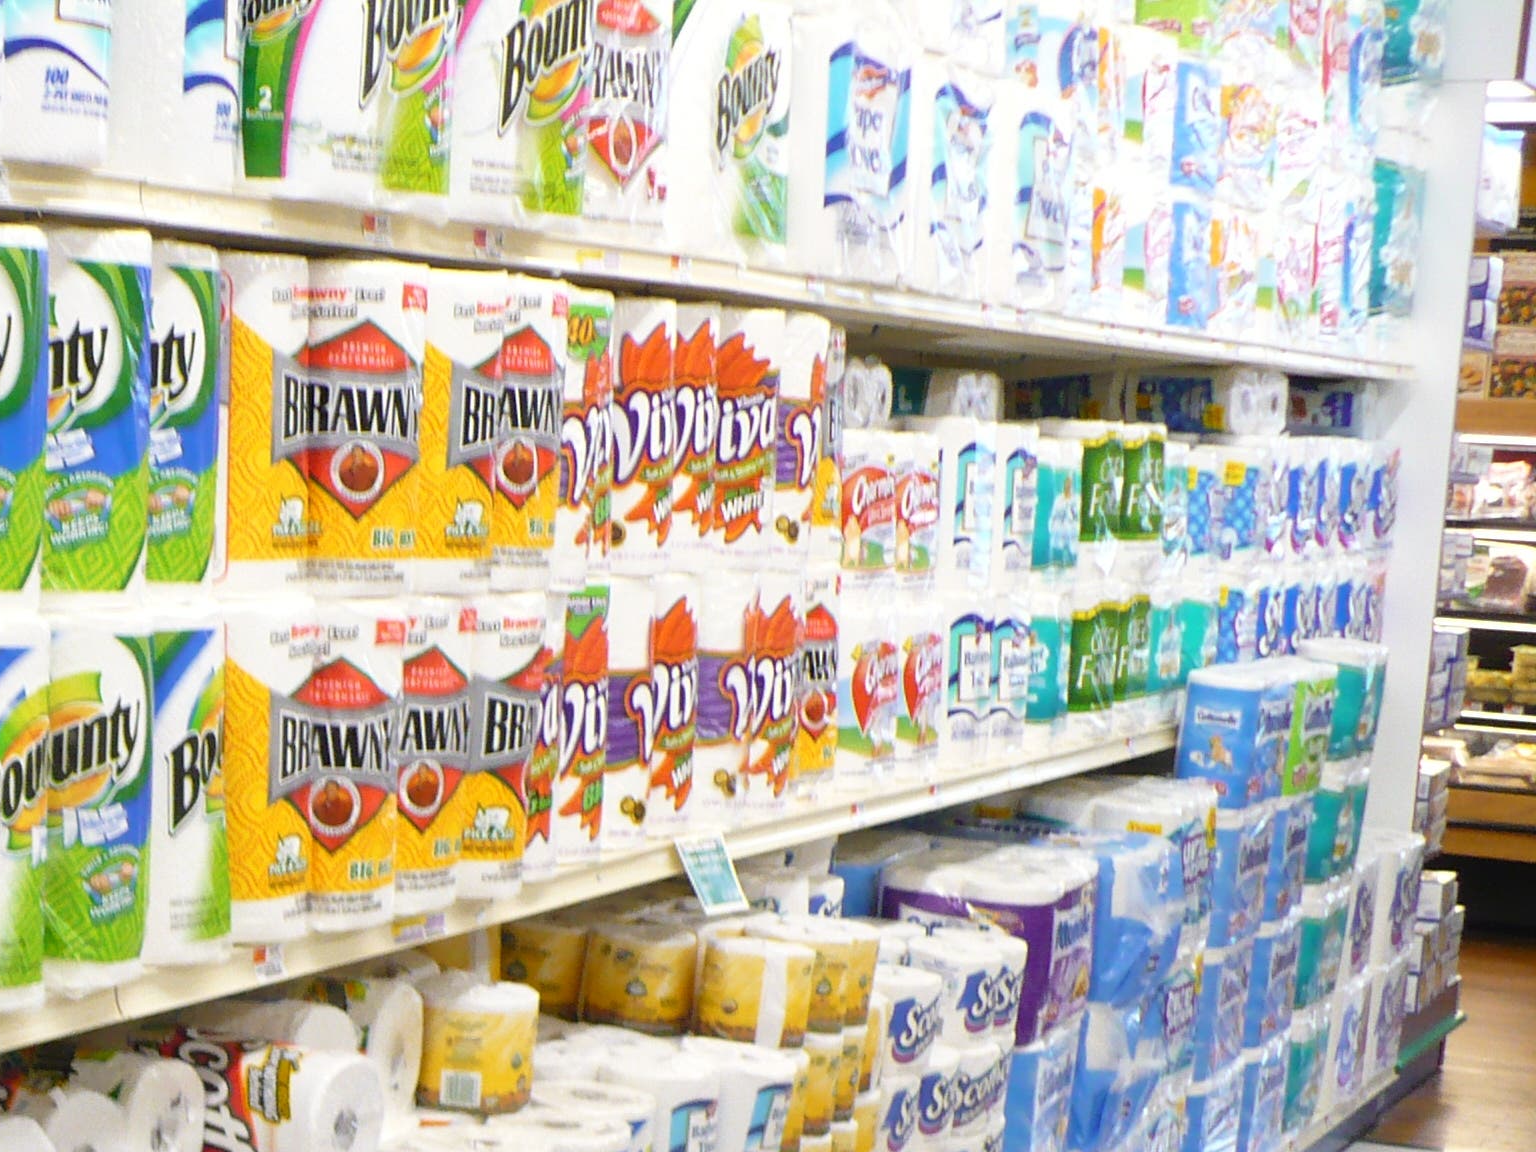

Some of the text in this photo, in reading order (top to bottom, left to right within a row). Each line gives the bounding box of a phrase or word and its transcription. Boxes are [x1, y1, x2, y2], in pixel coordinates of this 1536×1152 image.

[45, 68, 70, 85] 100
[258, 86, 273, 109] 2
[50, 321, 110, 402] nty
[152, 320, 197, 400] ty
[718, 397, 777, 463] iva
[484, 695, 538, 758] BRA
